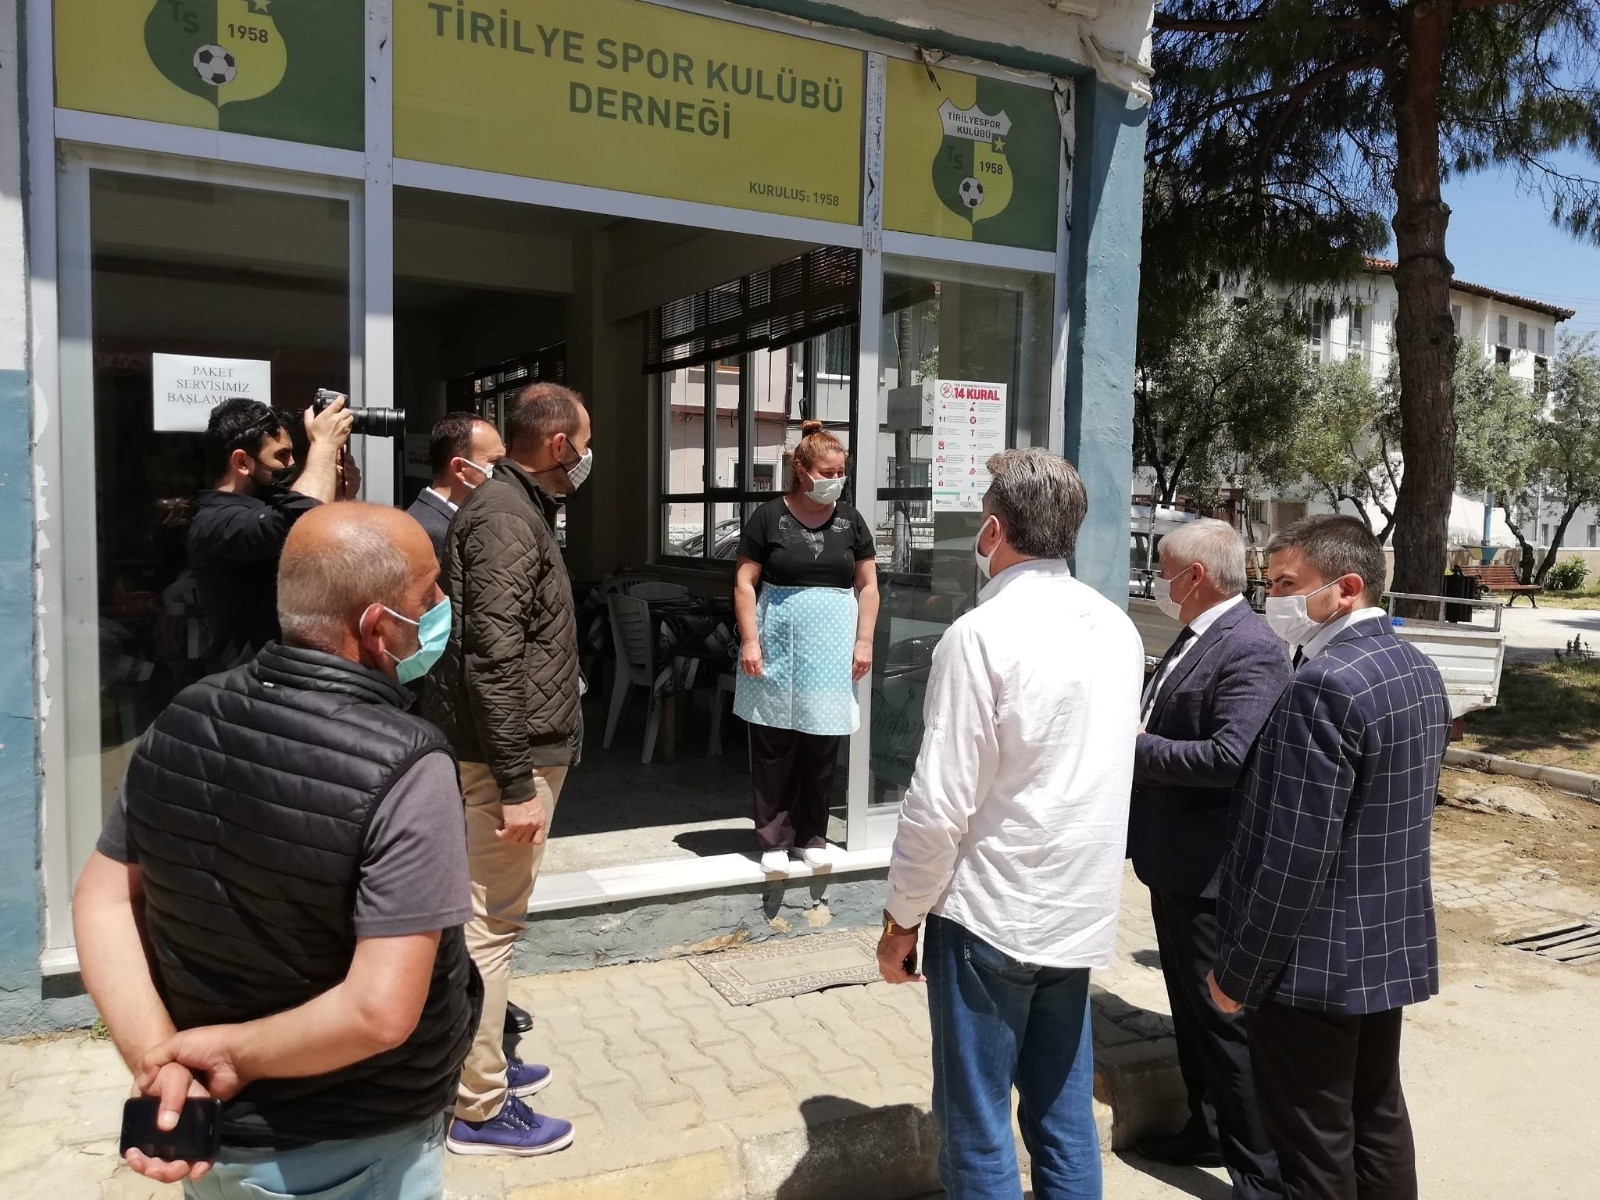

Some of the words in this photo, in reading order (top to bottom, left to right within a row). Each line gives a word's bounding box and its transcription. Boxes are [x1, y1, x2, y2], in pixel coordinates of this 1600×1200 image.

[227, 23, 268, 43] 1958
[427, 0, 585, 65] TİRİLYE
[596, 38, 694, 86] SPOR
[706, 59, 843, 113] KULÜBÜ
[569, 81, 730, 139] DERNEĞİ
[947, 111, 1001, 129] TİRİLYESPOR
[957, 125, 991, 139] KULÜBÜ
[979, 160, 1003, 175] 1958
[749, 181, 810, 203] KURULUŞ:
[813, 192, 839, 206] 1958
[193, 365, 234, 378] PAKET
[176, 378, 250, 393] SERVİSİMİZ
[954, 387, 965, 399] 14
[966, 388, 1000, 401] KURAL
